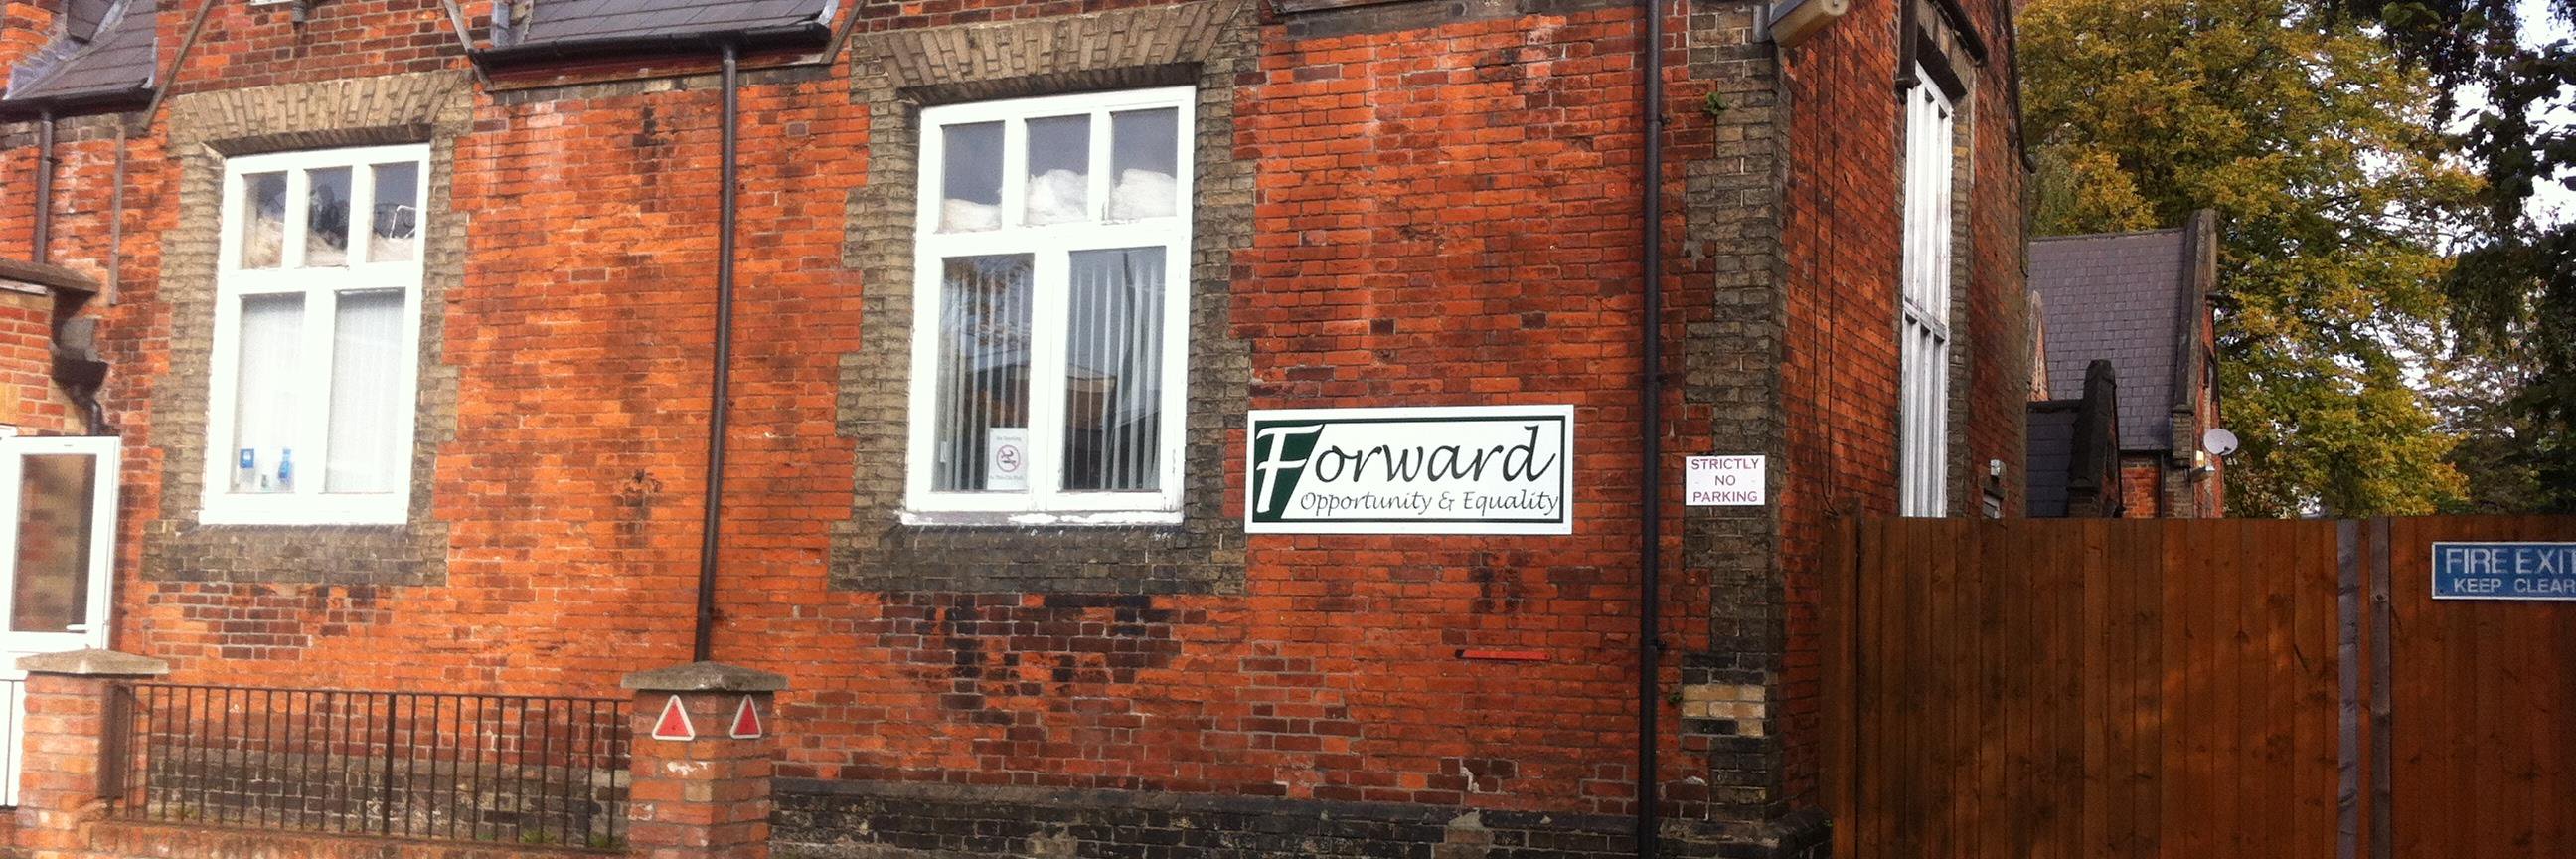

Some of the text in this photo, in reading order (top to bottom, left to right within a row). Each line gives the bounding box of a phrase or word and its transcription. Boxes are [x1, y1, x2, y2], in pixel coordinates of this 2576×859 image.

[1256, 424, 1557, 513] Forward
[1691, 458, 1759, 470] STRICTLY
[1714, 475, 1736, 486] NO
[1300, 489, 1559, 516] Opportunity & Equality
[1692, 491, 1758, 503] PARKING
[2446, 548, 2509, 574] FIRE
[2454, 578, 2576, 594] KEEP CLEAR
